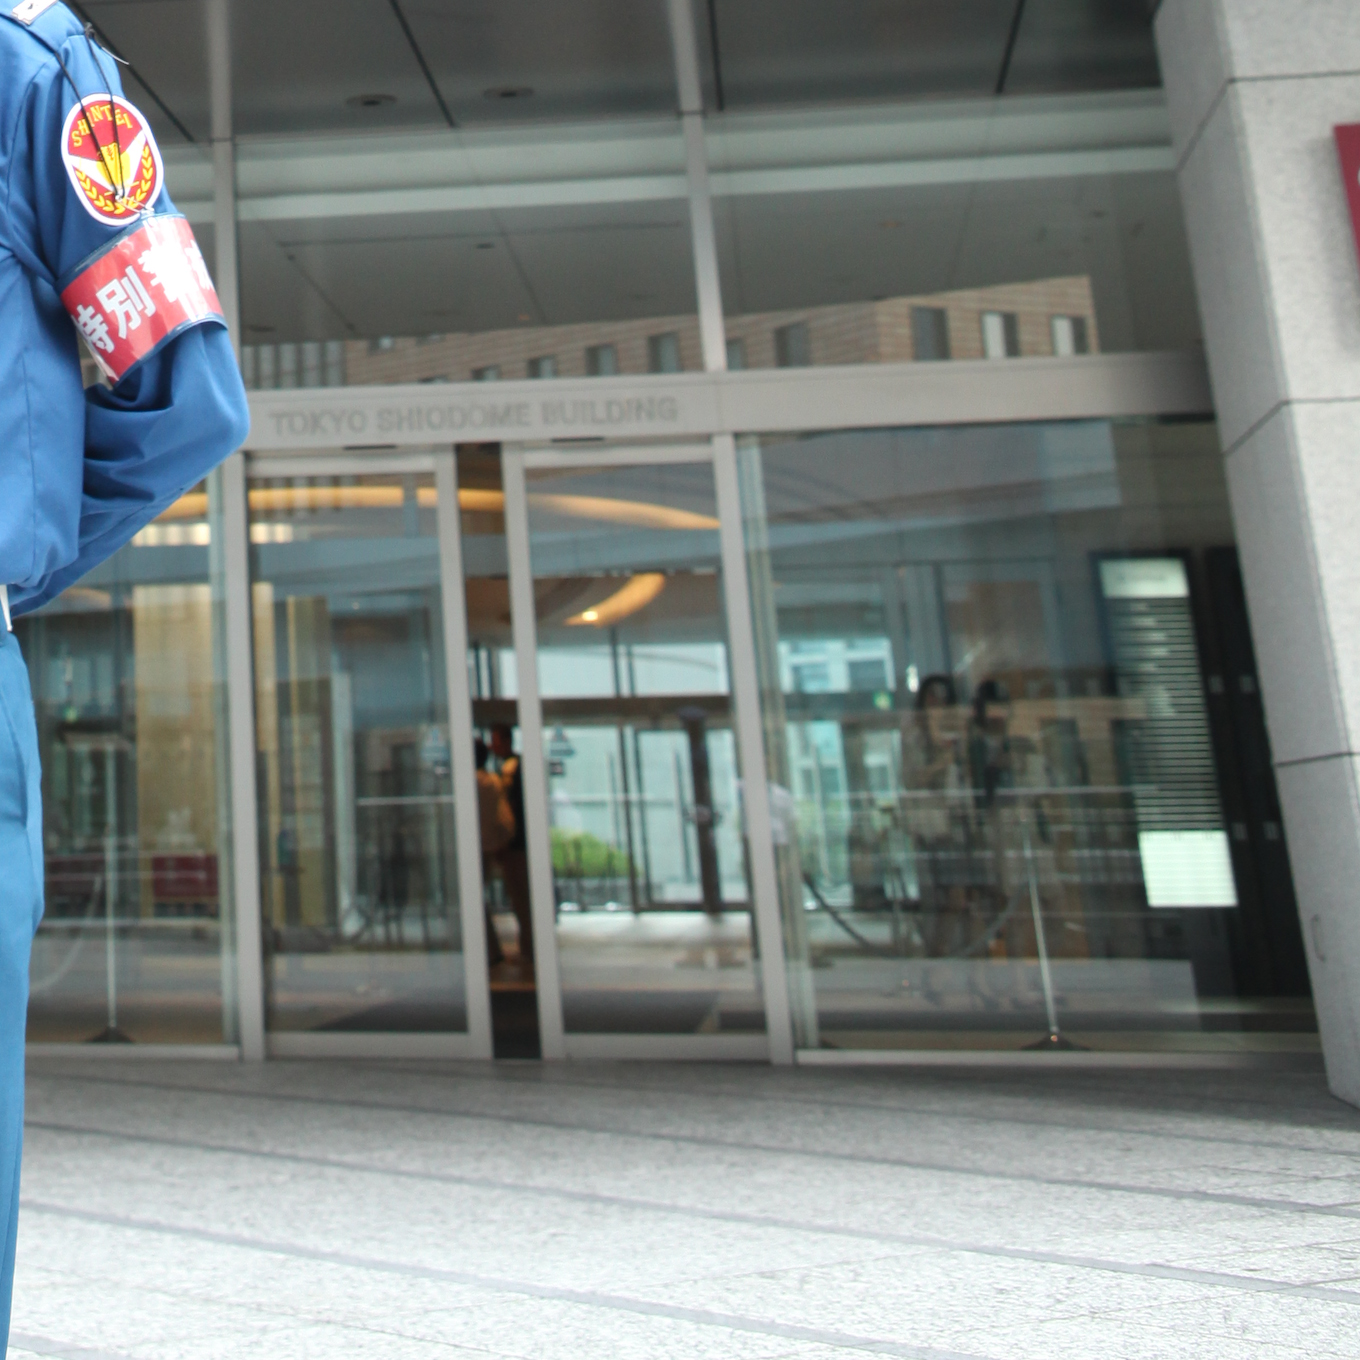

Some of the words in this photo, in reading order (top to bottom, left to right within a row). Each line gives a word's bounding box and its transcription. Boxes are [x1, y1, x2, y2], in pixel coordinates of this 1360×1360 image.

[71, 104, 133, 148] SHINTEI
[269, 408, 367, 436] TOKYO
[376, 401, 532, 433] SHIODOME
[541, 395, 679, 427] BUILDING
